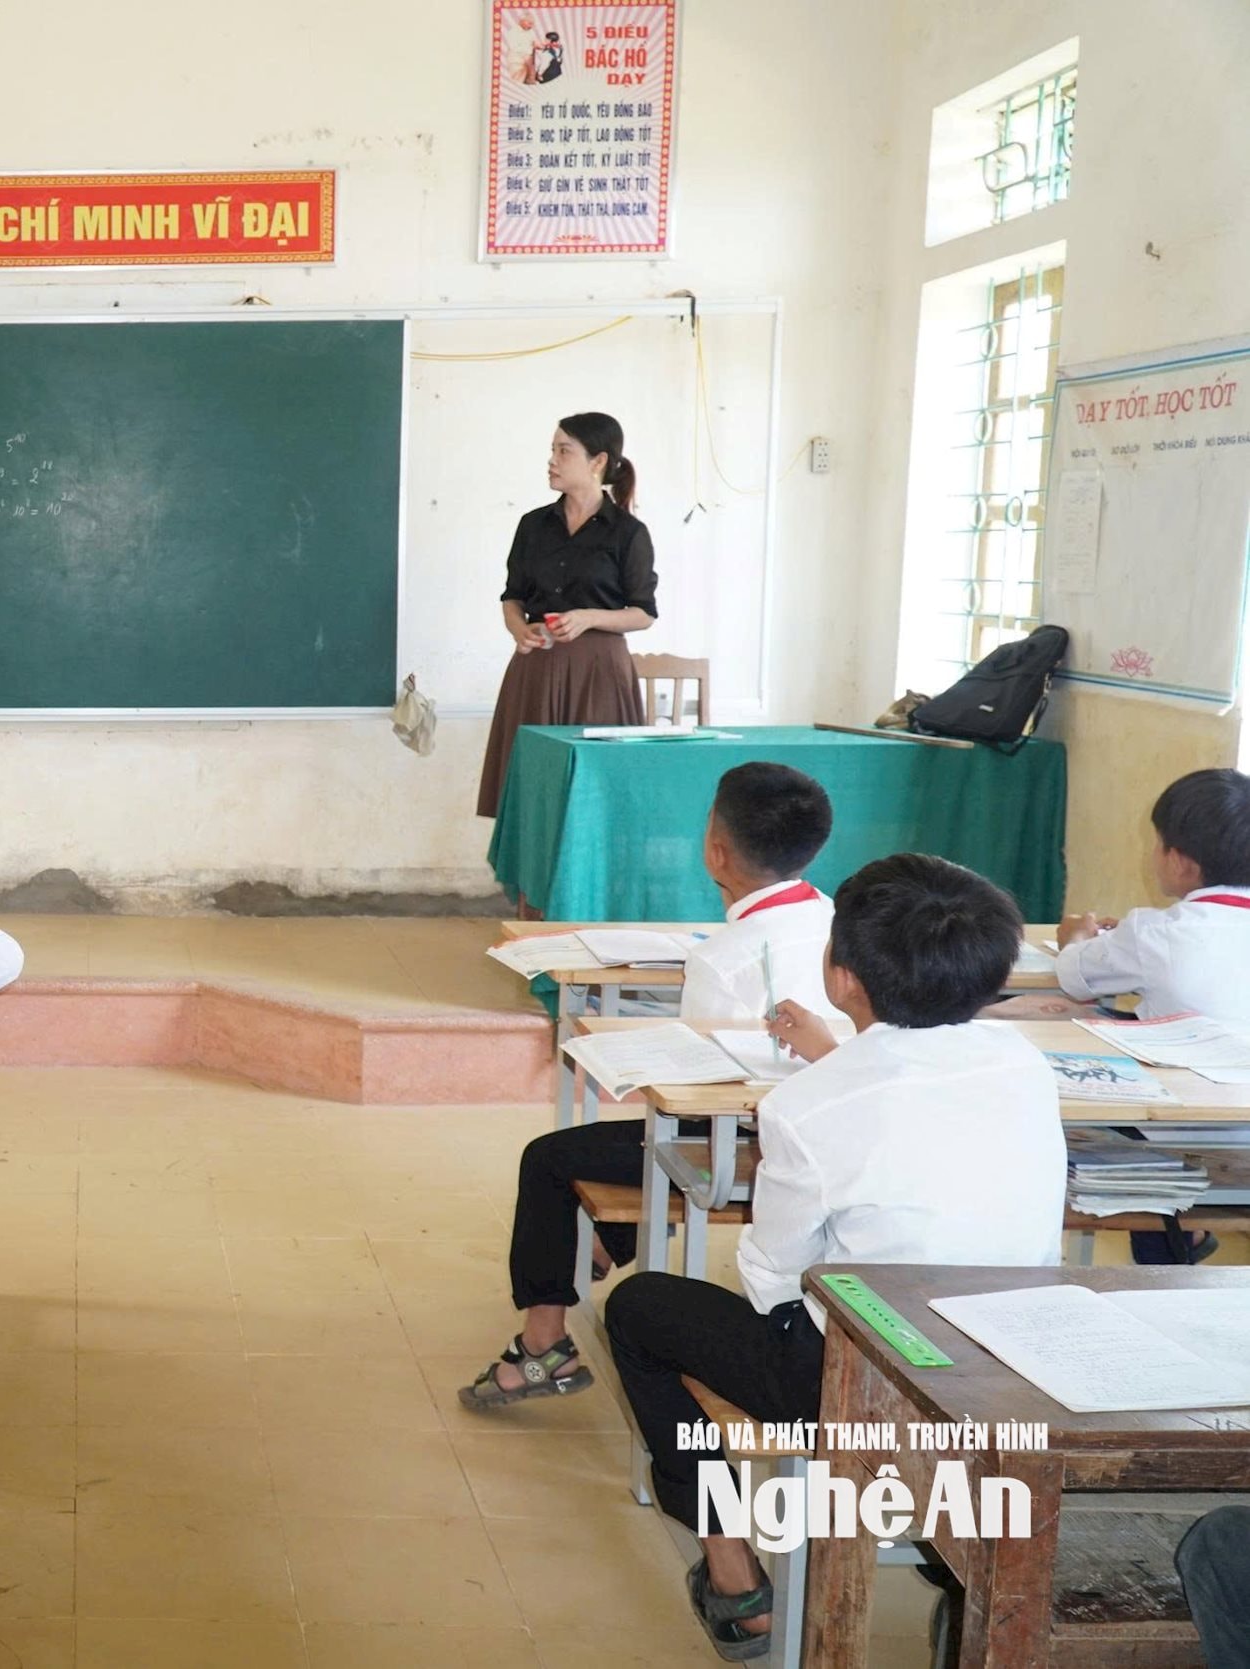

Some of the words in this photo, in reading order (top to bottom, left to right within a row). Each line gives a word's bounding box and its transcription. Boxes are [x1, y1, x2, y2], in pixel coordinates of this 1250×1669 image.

[586, 26, 597, 39] 5
[604, 23, 648, 39] ĐIỀU
[585, 44, 618, 68] BÁC
[624, 40, 647, 68] HỒ
[607, 73, 646, 87] DẠY
[73, 203, 181, 242] MINH
[192, 195, 232, 239] VĨ
[241, 201, 310, 246] ĐẠI
[1154, 388, 1195, 419] HỌC
[1199, 372, 1237, 410] TỐT
